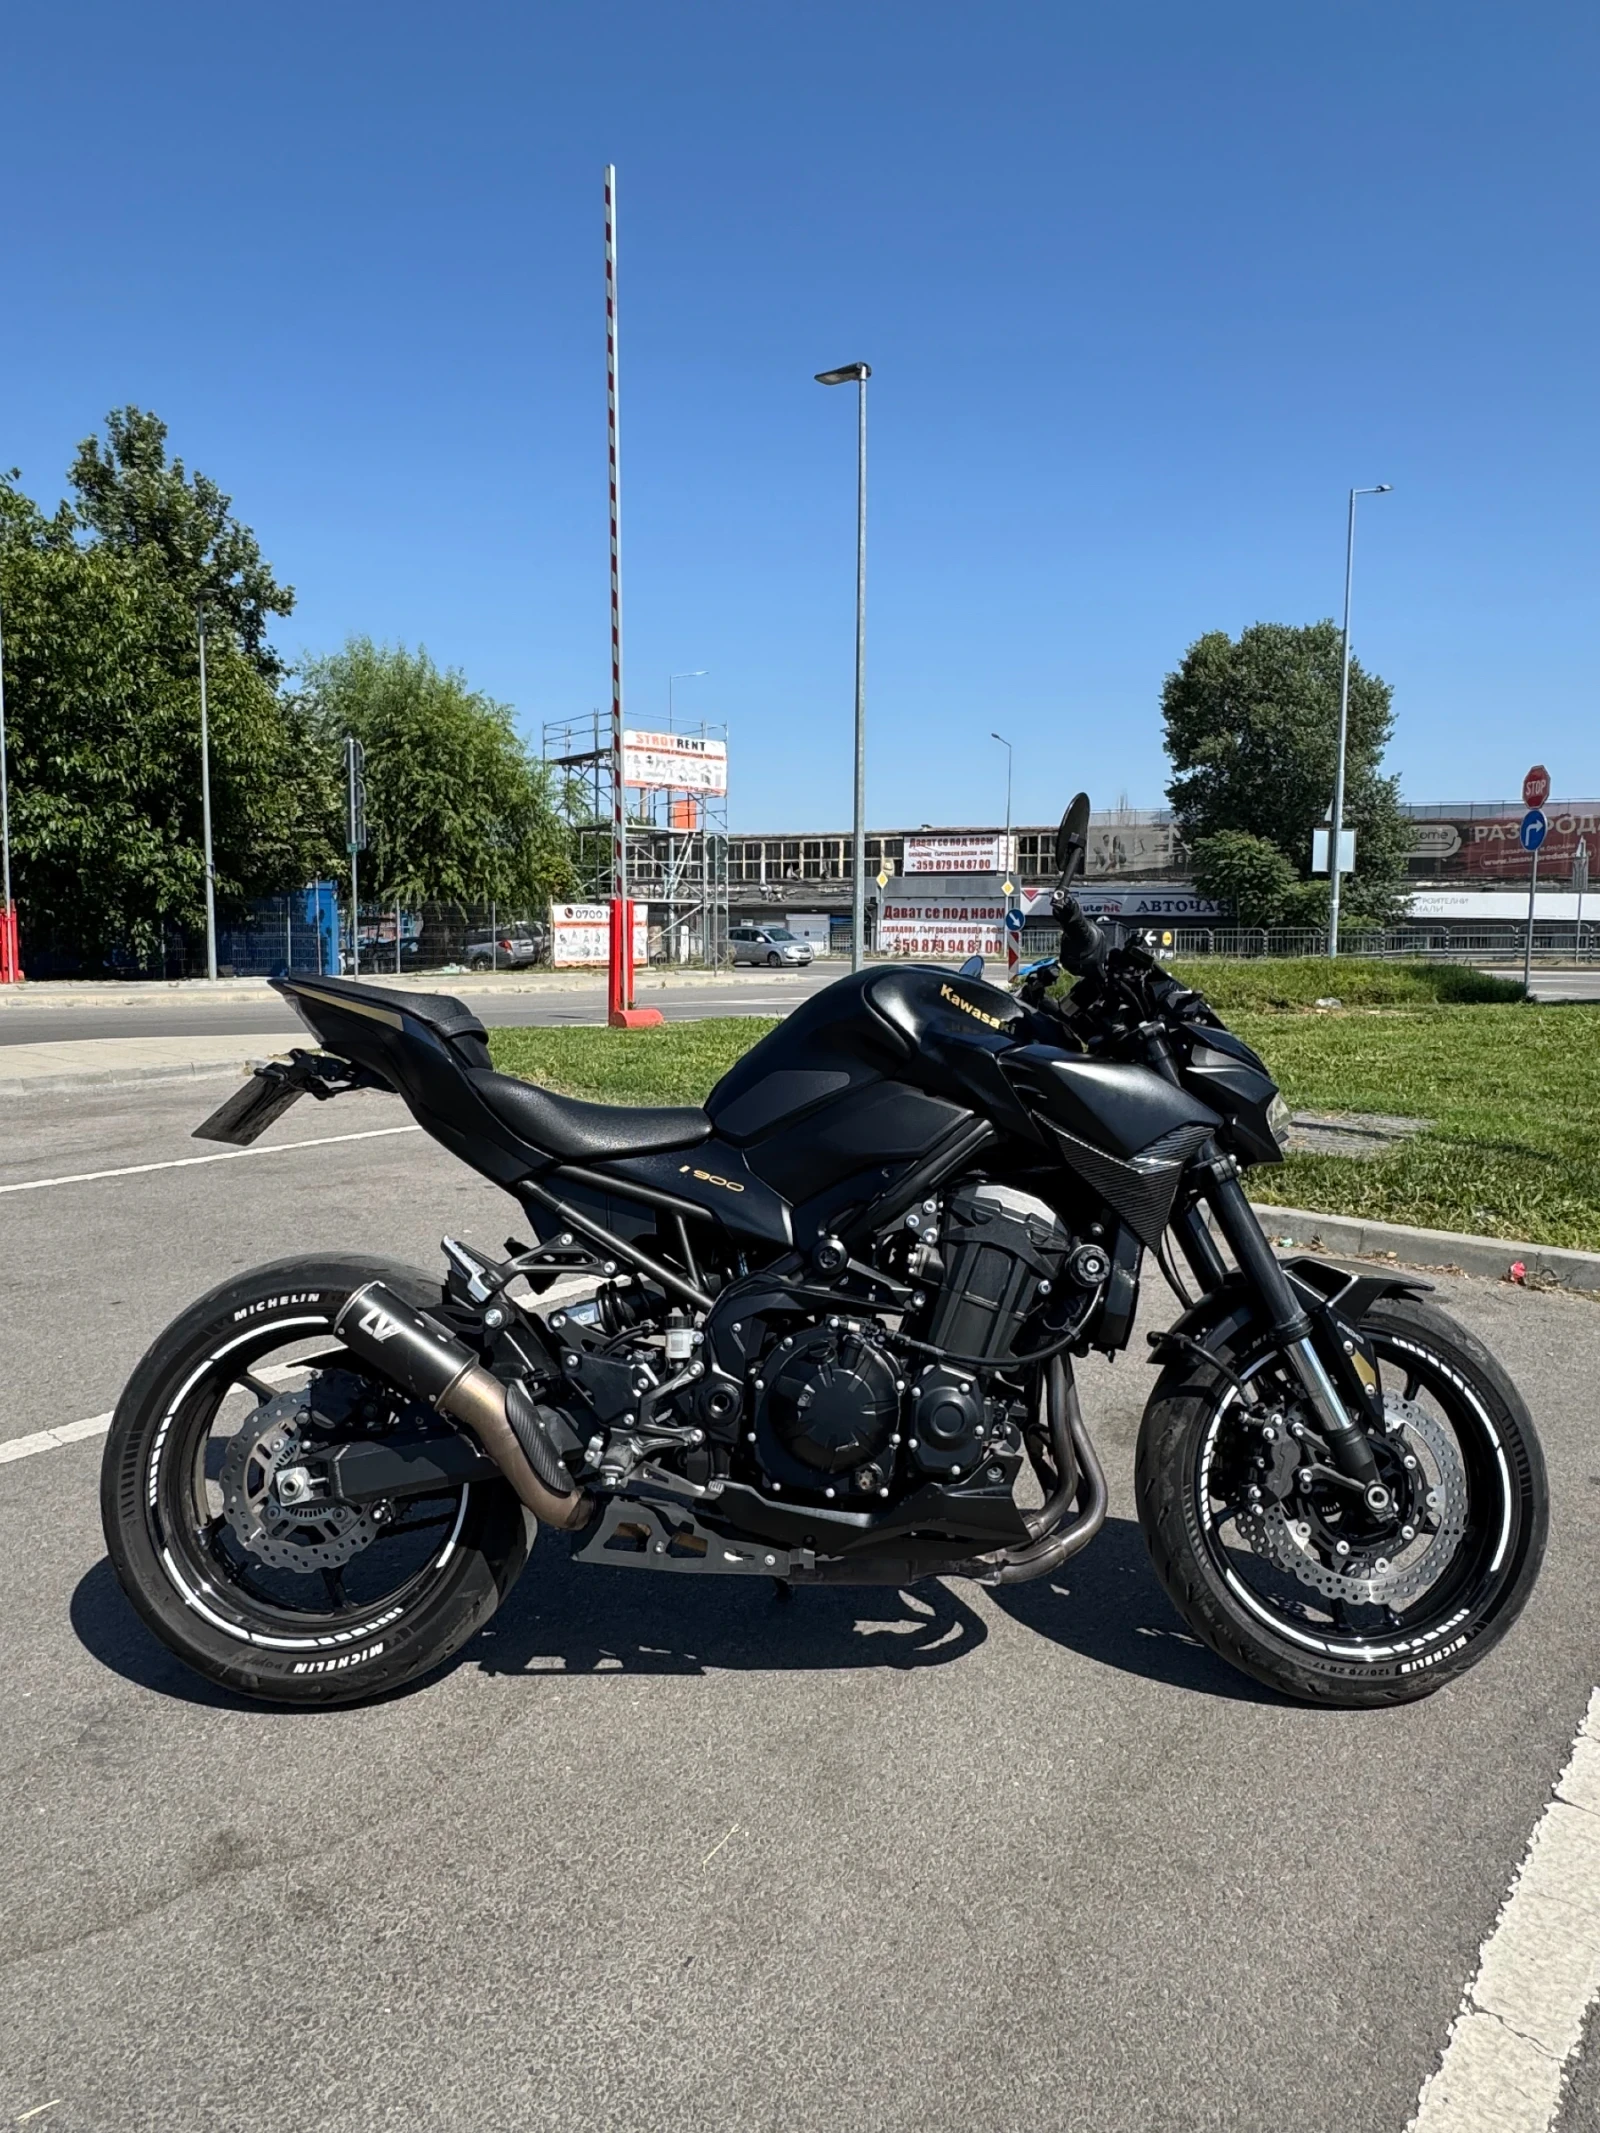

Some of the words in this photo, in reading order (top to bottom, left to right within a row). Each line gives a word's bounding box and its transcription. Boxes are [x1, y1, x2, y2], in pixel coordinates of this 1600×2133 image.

[1525, 779, 1547, 796] STOP
[908, 837, 936, 848] Дават
[937, 838, 949, 847] се
[950, 838, 968, 848] под
[969, 837, 994, 846] наем
[1419, 831, 1449, 840] ome
[911, 860, 934, 870] +359
[935, 860, 953, 870] 879
[575, 909, 603, 919] 0700
[883, 905, 923, 920] Дават
[925, 907, 940, 919] се
[942, 907, 968, 921] под
[970, 907, 1005, 920] наем
[886, 938, 919, 953] +359
[921, 938, 945, 953] 879
[947, 939, 965, 953] 94
[985, 940, 1002, 954] 00
[940, 983, 1017, 1035] Kawasaki
[233, 1292, 321, 1321] MICHELIN
[292, 1643, 384, 1674] MICHELIN
[1400, 1634, 1467, 1674] MICHELIN
